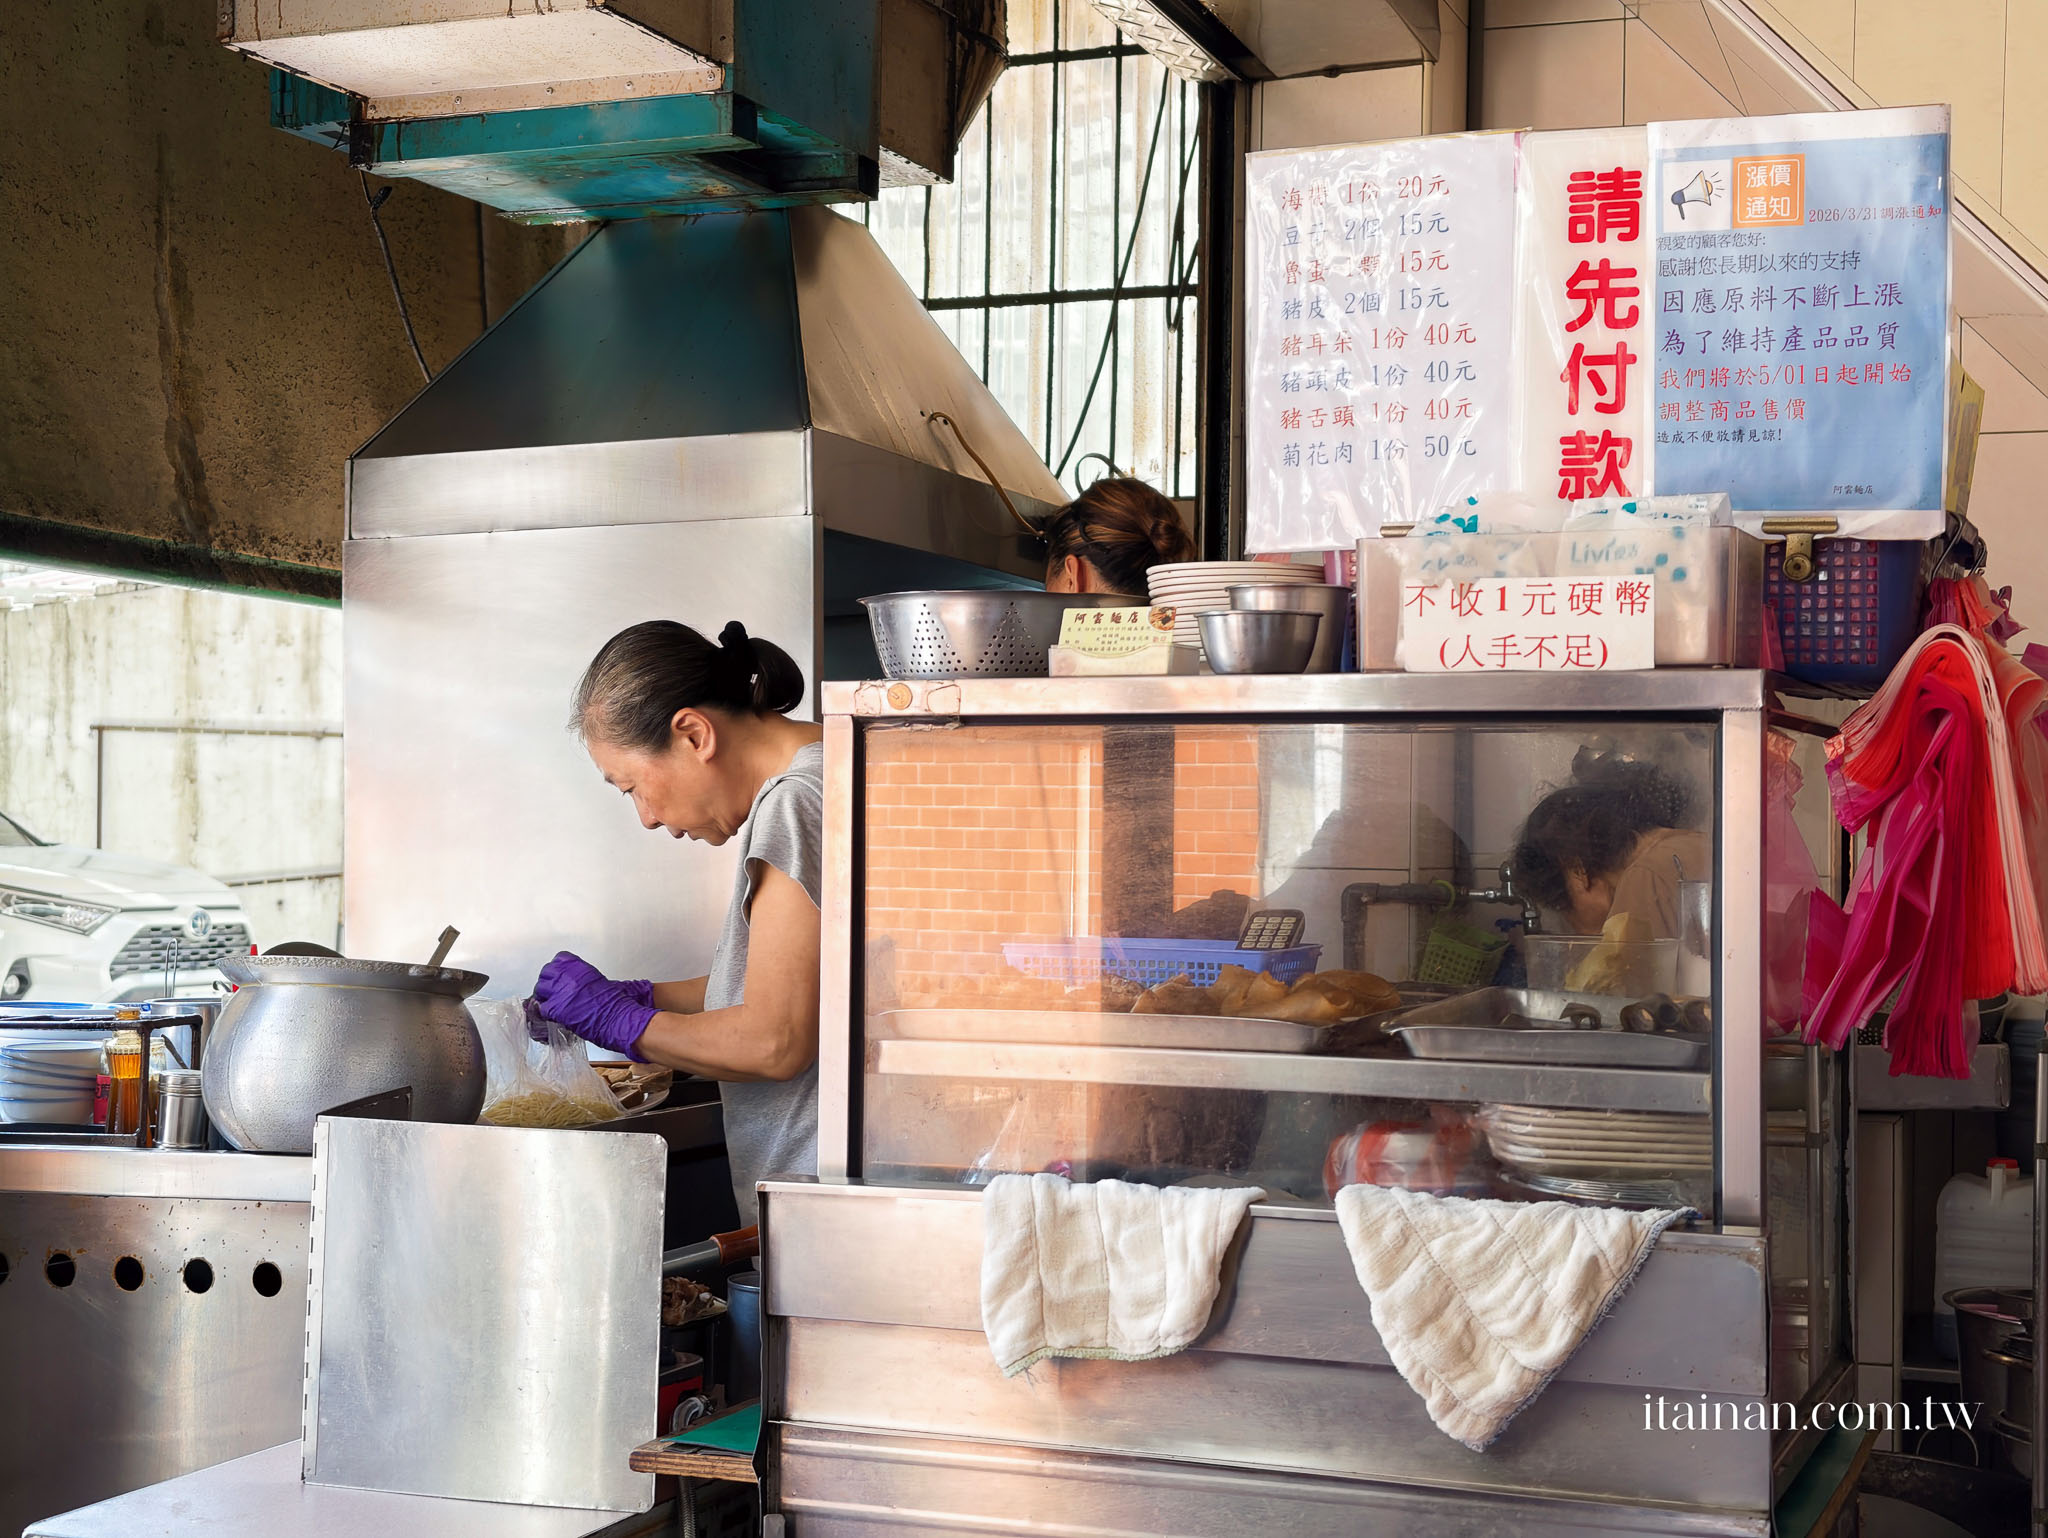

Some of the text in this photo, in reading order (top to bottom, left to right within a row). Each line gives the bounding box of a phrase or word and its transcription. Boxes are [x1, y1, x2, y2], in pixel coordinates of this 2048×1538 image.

[1346, 181, 1380, 204] 1份
[1397, 175, 1450, 199] 20元
[1746, 164, 1791, 188] 漲價
[1746, 196, 1790, 218] 通知
[1808, 204, 1942, 223] 2026/3/31調漲通知
[1345, 217, 1380, 241] 2個
[1399, 211, 1450, 236] 15元
[1399, 249, 1450, 273] 15元
[1659, 250, 1860, 277] 感謝您長期以來的支持
[1281, 286, 1450, 321] 豬皮 2個 15元
[1663, 282, 1904, 314] 因應原料不斷上漲
[1280, 322, 1477, 357] 豬耳朵 1份 40元
[1558, 166, 1643, 502] 請先付款
[1661, 321, 1901, 355] 為了維持產品品質
[1280, 359, 1477, 393] 豬頭皮 1份 40元
[1658, 362, 1912, 390] 我們將於5/01日起開始
[1280, 397, 1474, 430] 豬舌頭 1份 40元
[1659, 397, 1806, 422] 調整商品售價
[1282, 434, 1477, 468] 菊花肉 1份 50元
[1404, 580, 1652, 618] 不收1元硬幣
[1439, 634, 1609, 671] (人手不足)
